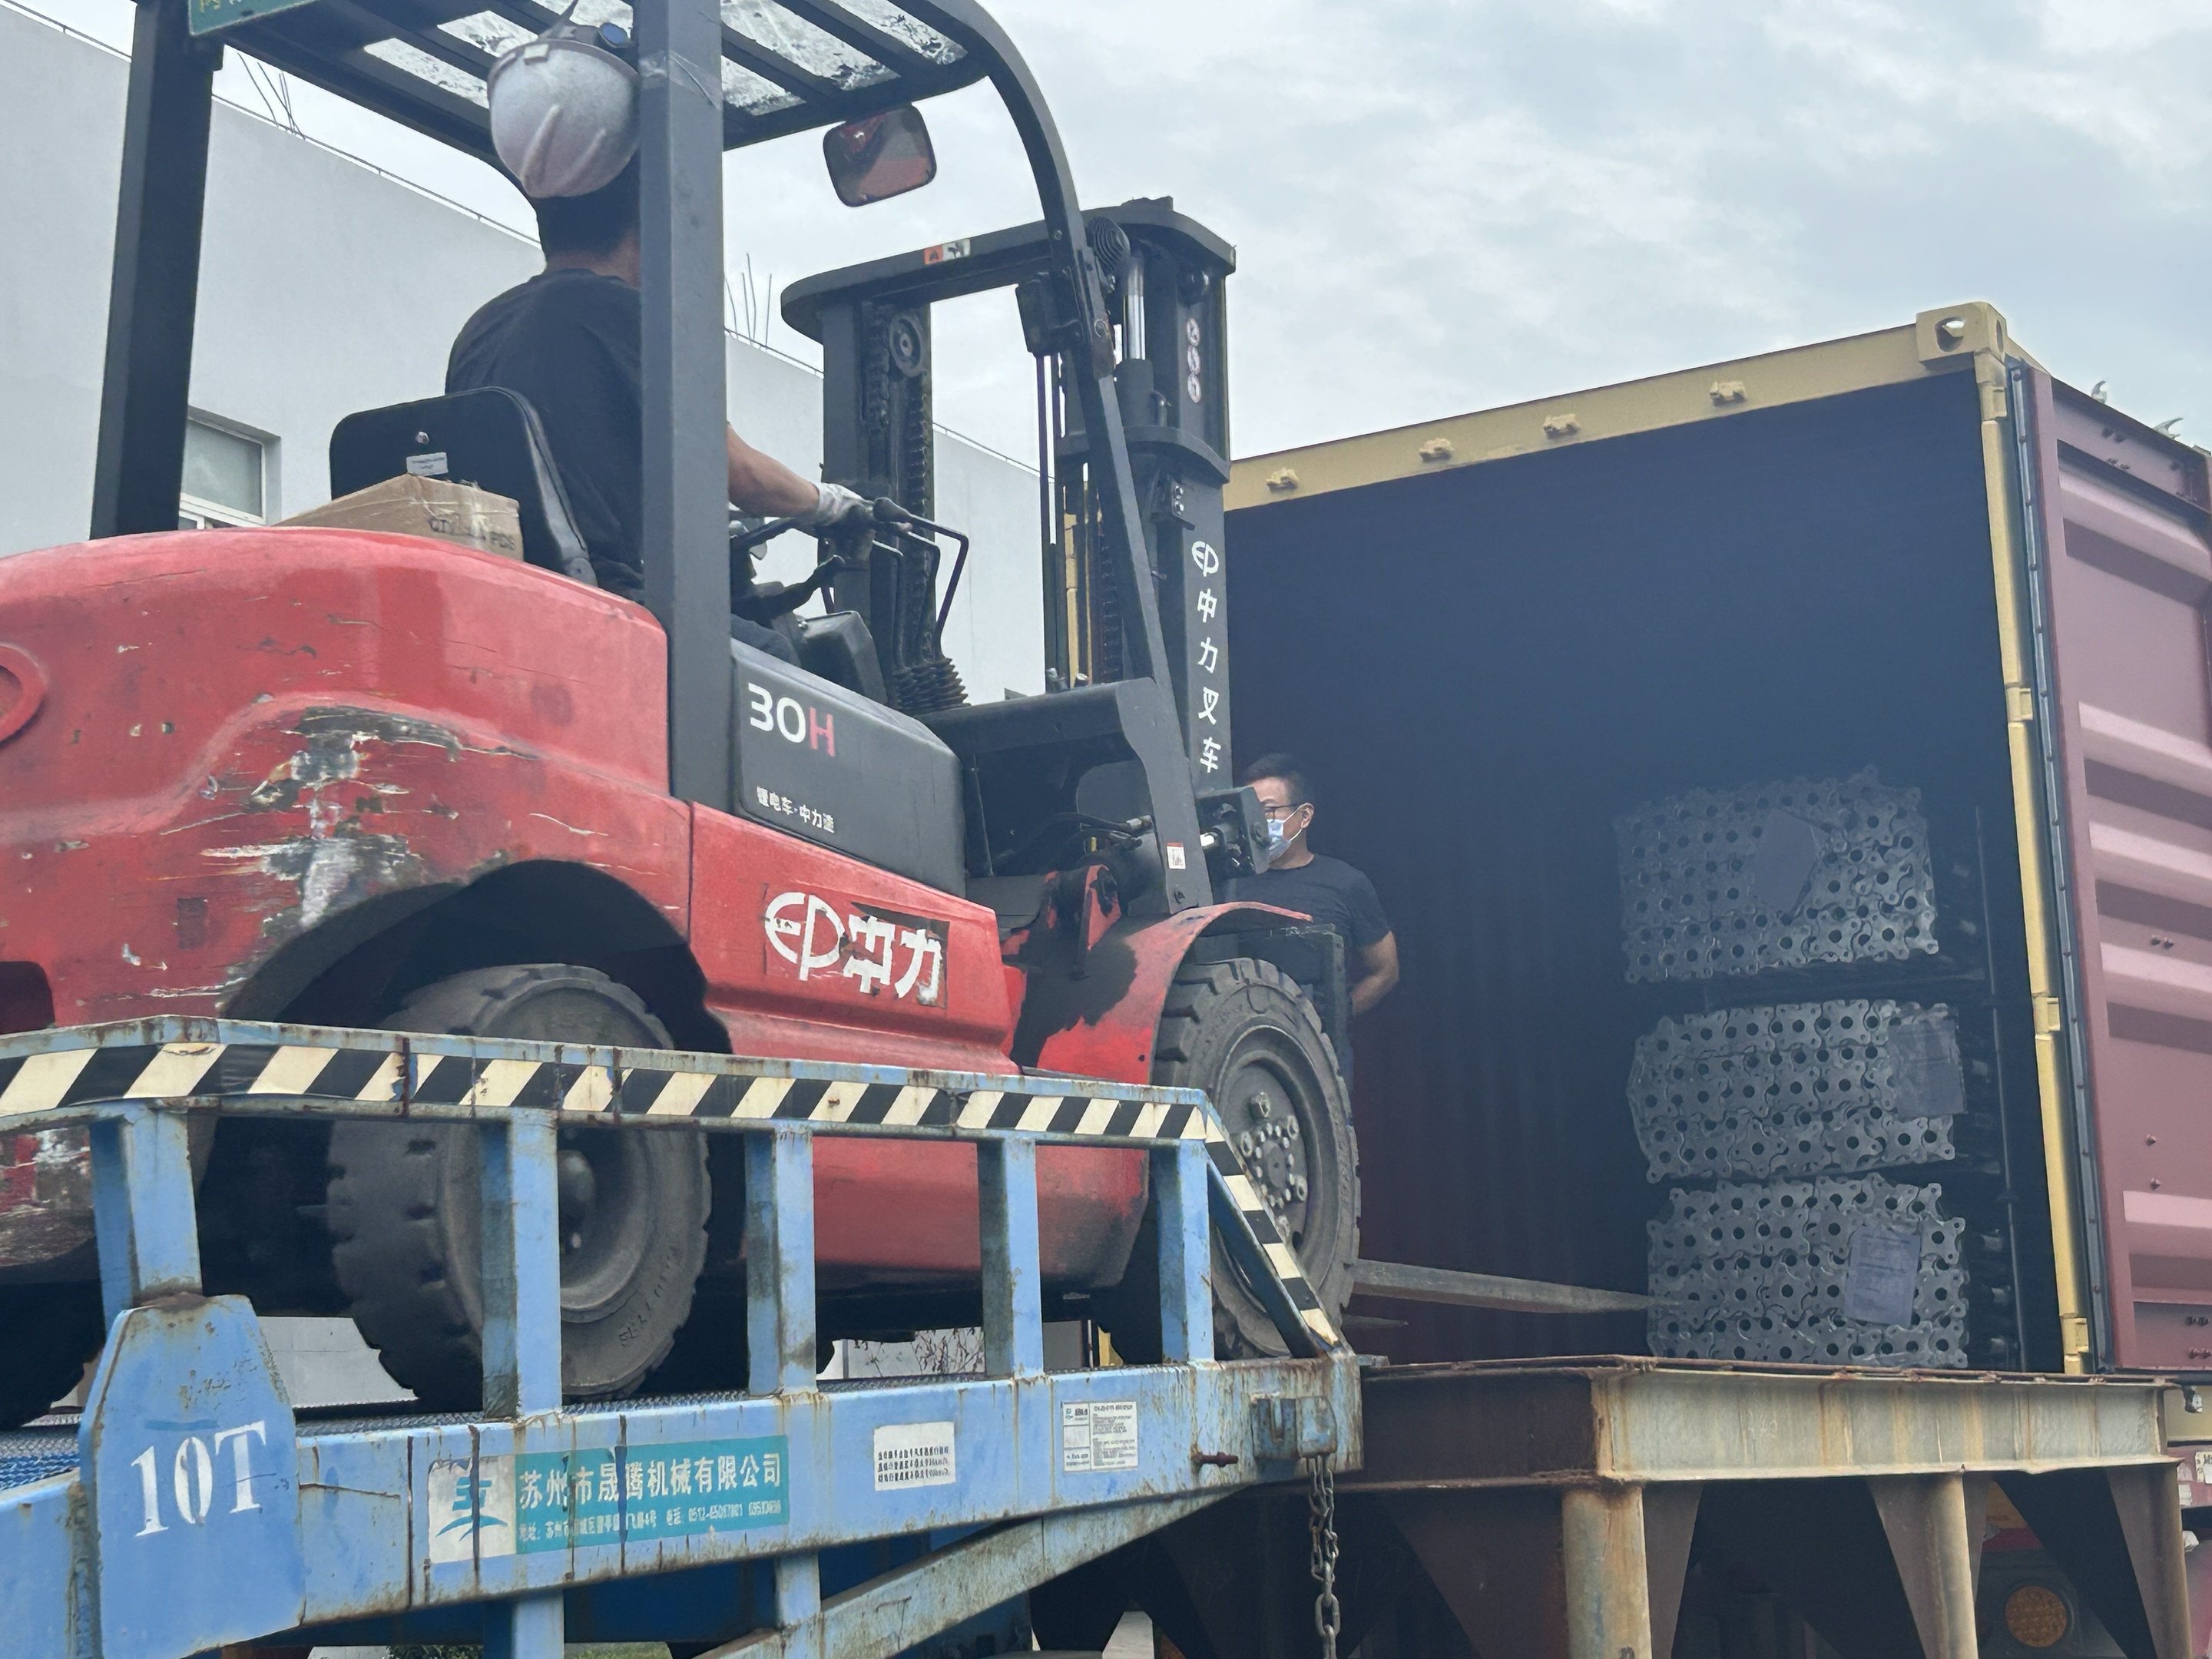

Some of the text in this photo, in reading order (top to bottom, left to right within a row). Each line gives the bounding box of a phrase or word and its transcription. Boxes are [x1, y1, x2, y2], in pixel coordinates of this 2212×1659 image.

[747, 683, 836, 757] 30H
[1197, 588, 1221, 773] 中力叉车
[843, 914, 943, 1005] 中力
[130, 1419, 268, 1538] 10T
